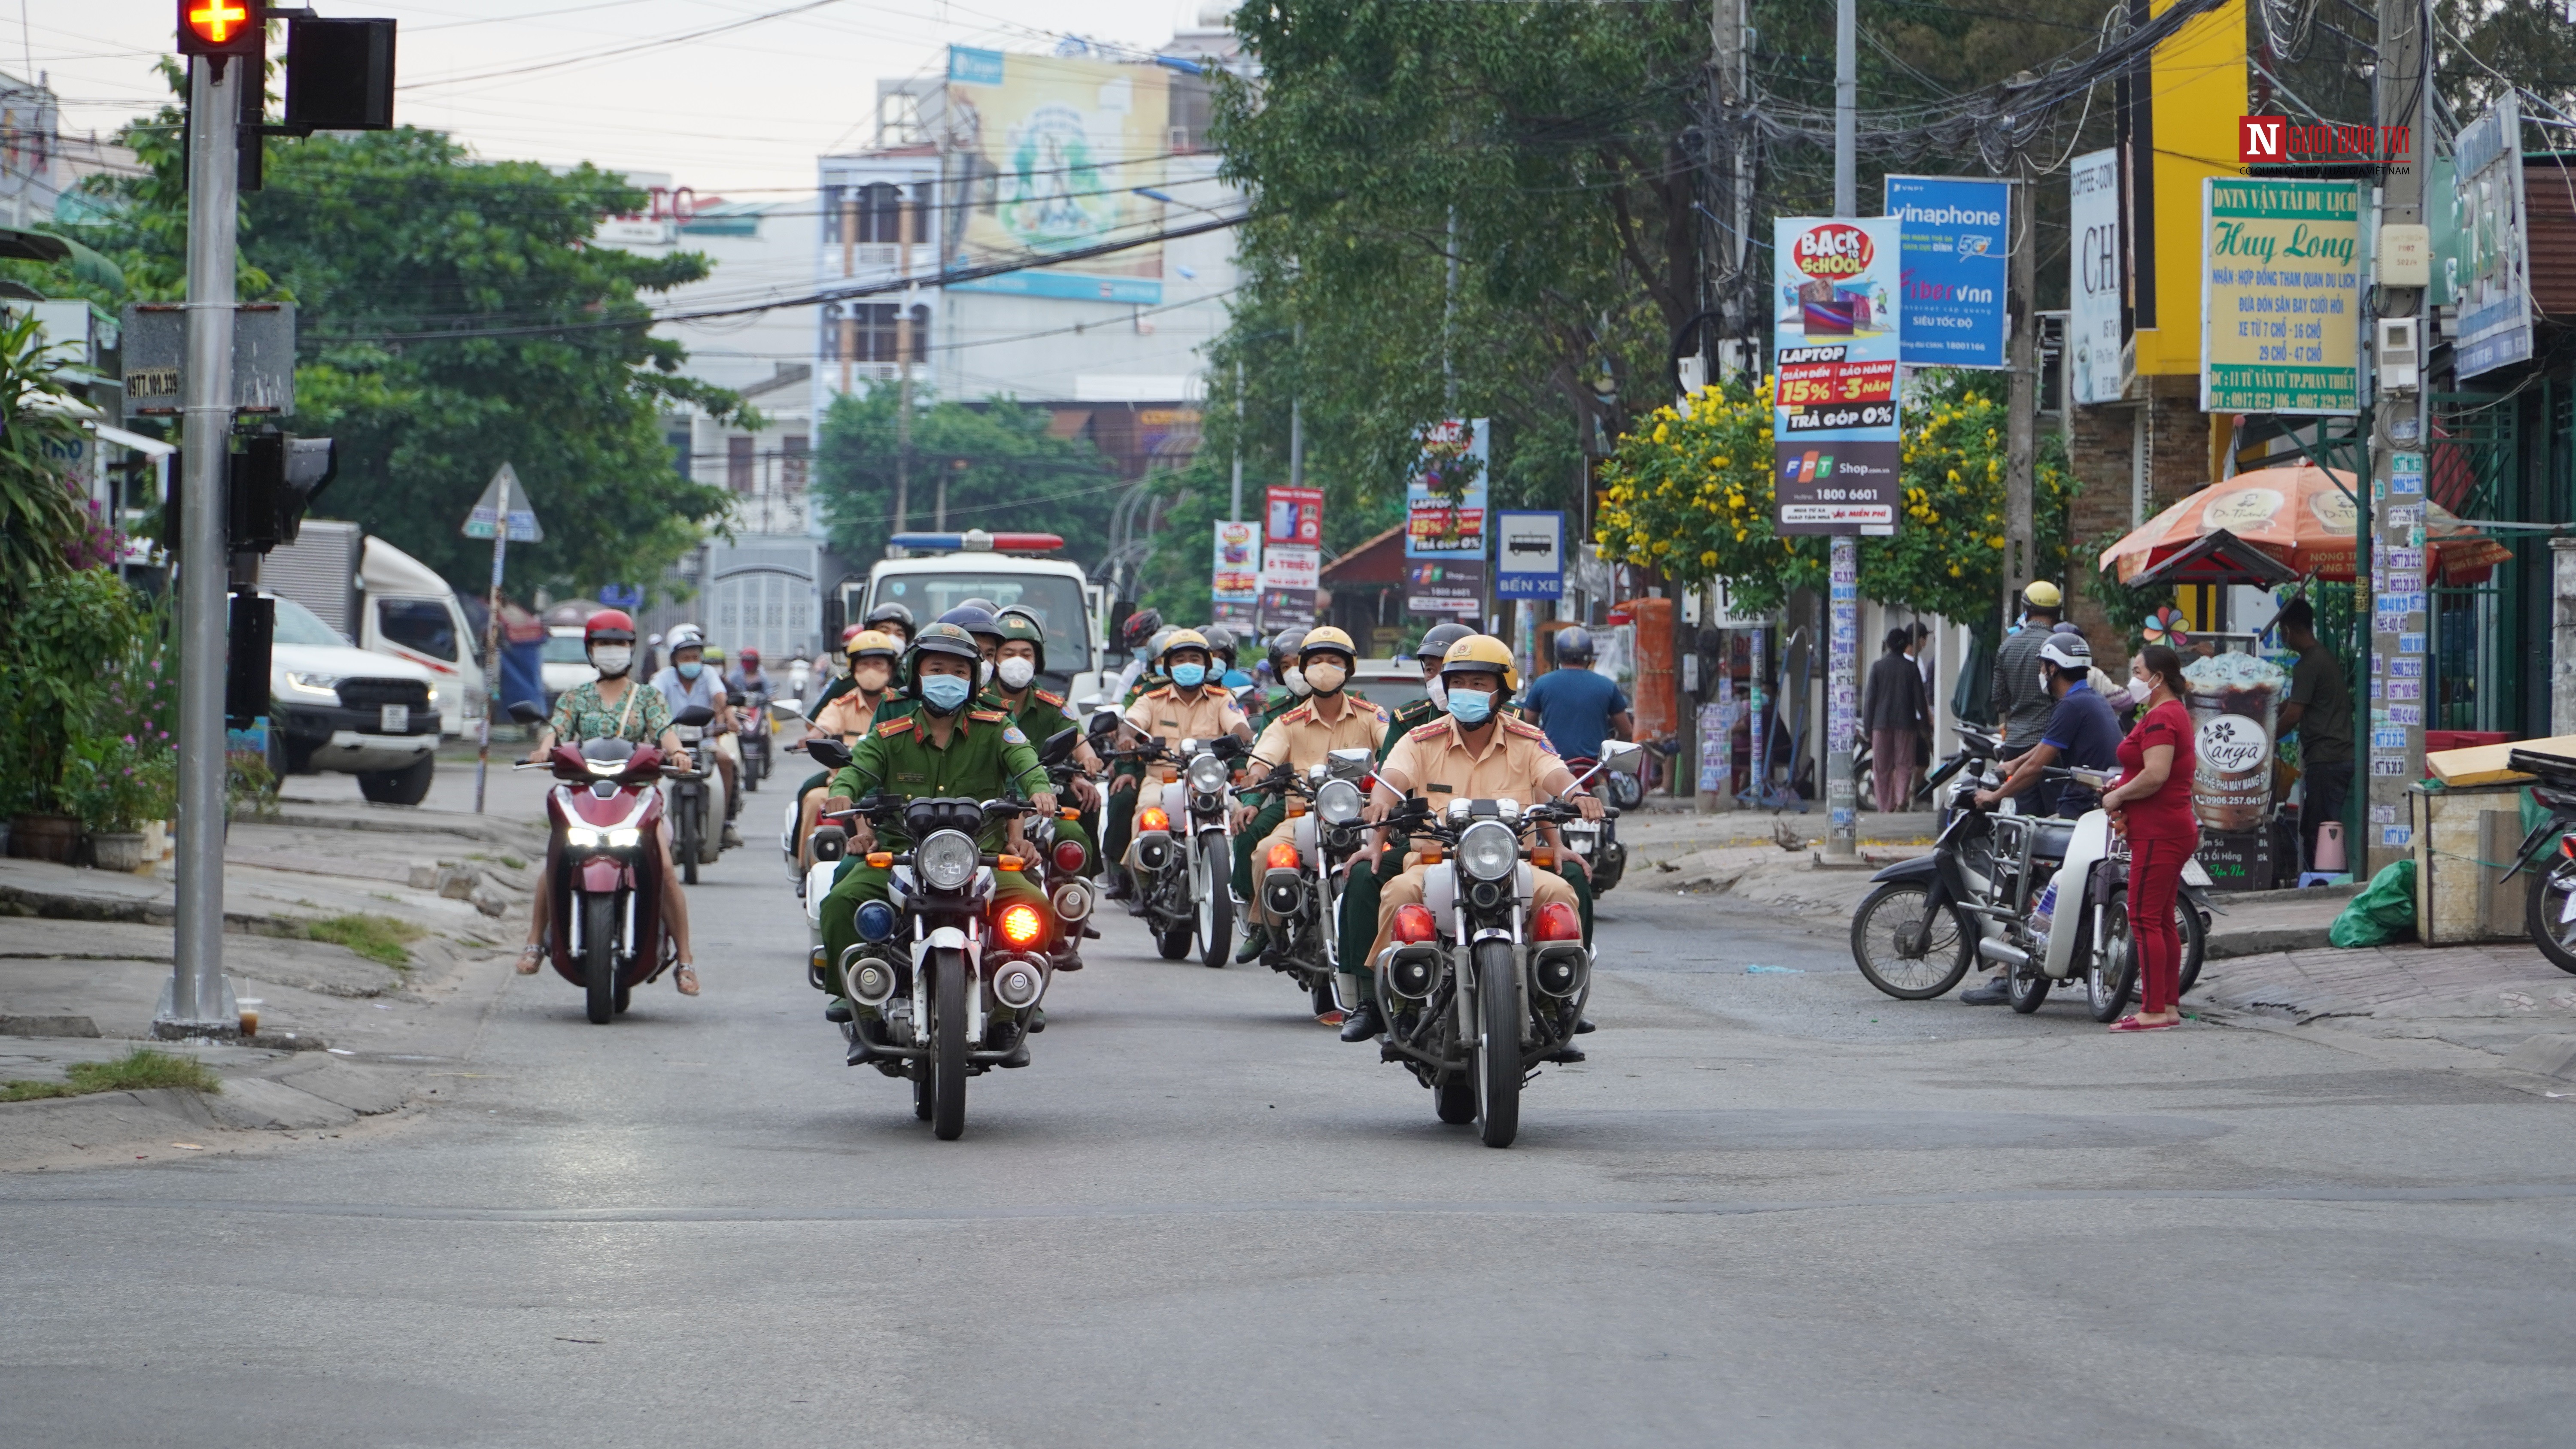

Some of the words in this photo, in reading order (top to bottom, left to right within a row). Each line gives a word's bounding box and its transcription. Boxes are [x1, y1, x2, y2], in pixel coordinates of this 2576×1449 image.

[2251, 184, 2277, 215] VẬN
[2281, 183, 2303, 210] TẢI
[2307, 191, 2323, 211] DU
[2327, 191, 2357, 217] LỊCH
[1893, 203, 2001, 226] vinaphone
[1801, 230, 1861, 257] BACK
[2215, 221, 2277, 264] Huy
[2283, 223, 2356, 267] Long
[1847, 249, 1859, 259] TO
[2279, 271, 2301, 288] THAM
[2304, 272, 2323, 290] QUAN
[2326, 273, 2336, 288] DU
[2293, 298, 2307, 312] BAY
[2239, 321, 2248, 336] XE
[2294, 323, 2304, 338] 16
[1780, 347, 1845, 364] LAPTOP
[2259, 346, 2269, 361] 29
[2294, 346, 2303, 361] 47
[1782, 367, 1807, 381] GIẢM
[1808, 365, 1831, 379] ĐẾN
[1839, 364, 1862, 377] BẢO
[1862, 364, 1893, 374] HÀNH
[1782, 380, 1830, 403] 15%
[1843, 377, 1863, 399] 3
[1862, 379, 1891, 393] NĂM
[1790, 409, 1820, 429] TRẢ
[1862, 406, 1892, 424] 0%
[1816, 488, 1846, 501] 1800
[1849, 488, 1877, 501] 6601
[1500, 576, 1533, 592] BẾN
[1537, 579, 1559, 592] XE
[2217, 779, 2228, 791] PHA
[2242, 775, 2260, 791] MANG
[2206, 796, 2261, 806] 0906.257.041
